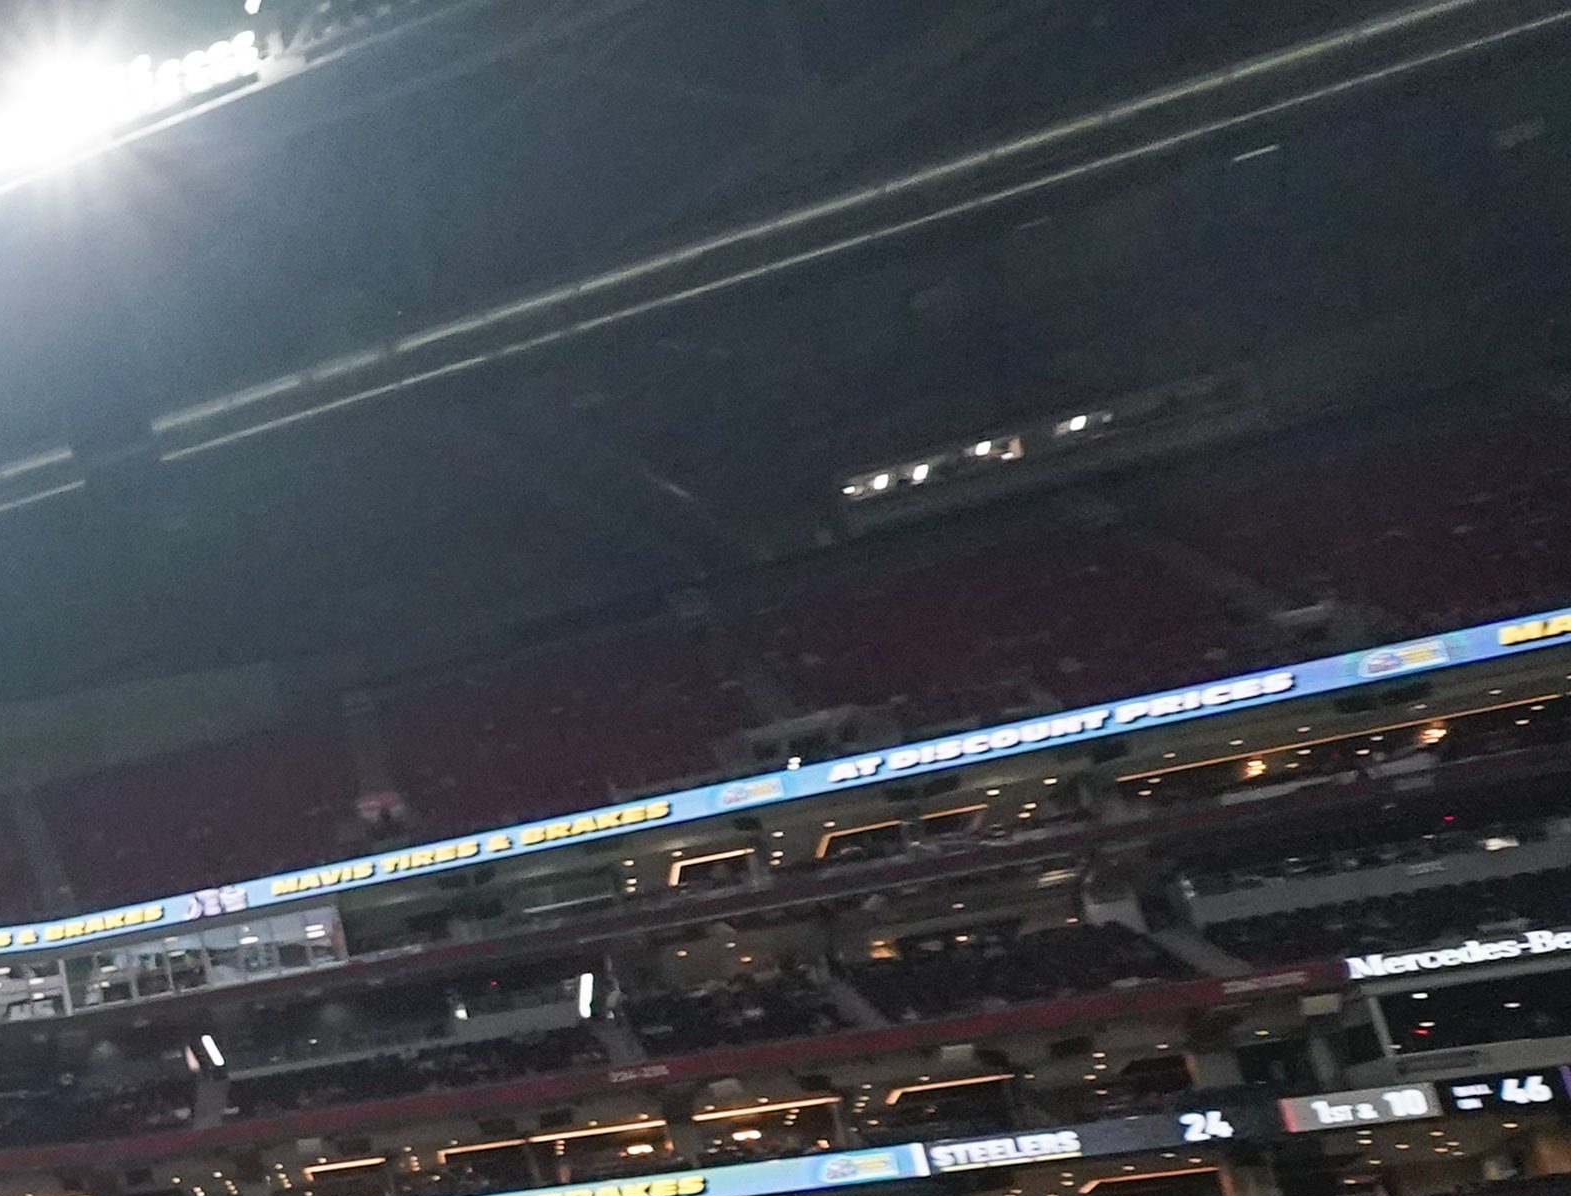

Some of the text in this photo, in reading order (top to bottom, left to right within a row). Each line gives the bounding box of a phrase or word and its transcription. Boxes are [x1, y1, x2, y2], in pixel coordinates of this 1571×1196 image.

[827, 672, 1296, 783] AT DISCOUNT PRICES
[271, 801, 672, 895] MAVIS TIRES & BRAKES
[17, 928, 38, 945] &
[45, 905, 164, 942] BRAKES
[1381, 1088, 1429, 1117] 10
[1500, 1075, 1553, 1104] 46
[1178, 1110, 1235, 1142] 24
[928, 1131, 1082, 1171] STEELERS
